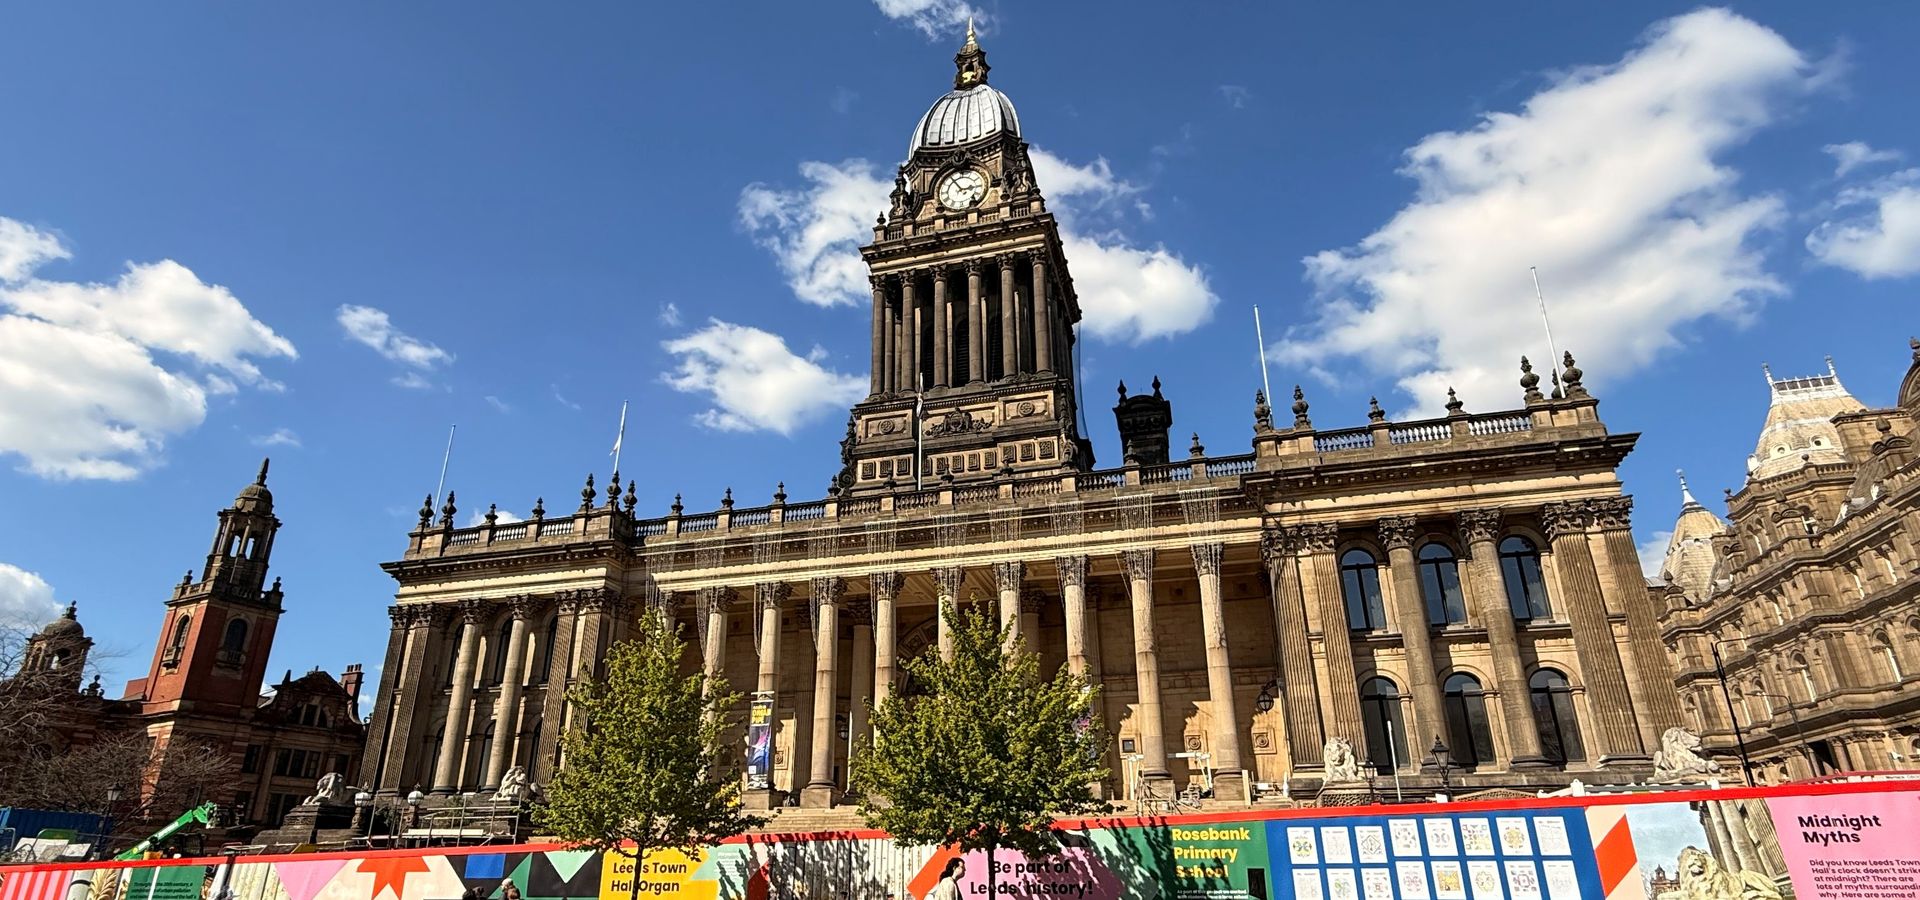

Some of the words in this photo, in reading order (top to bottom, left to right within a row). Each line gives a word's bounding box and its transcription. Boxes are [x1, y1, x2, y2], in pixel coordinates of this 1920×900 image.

[1797, 814, 1882, 831] Midnight
[1172, 827, 1251, 841] Rosebank
[1803, 831, 1861, 847] Myths
[1174, 845, 1238, 863] Primary
[613, 862, 649, 874] Lees
[652, 862, 687, 874] Town
[993, 861, 1011, 874] Be
[1015, 861, 1050, 878] part
[1053, 859, 1071, 873] of
[1176, 865, 1229, 878] School
[1825, 860, 1842, 868] you
[1825, 875, 1870, 884] midnight?
[611, 880, 634, 892] Hal
[639, 880, 679, 896] Organ
[970, 881, 1021, 895] Leds'
[1026, 881, 1093, 899] history!
[1844, 883, 1874, 892] myths
